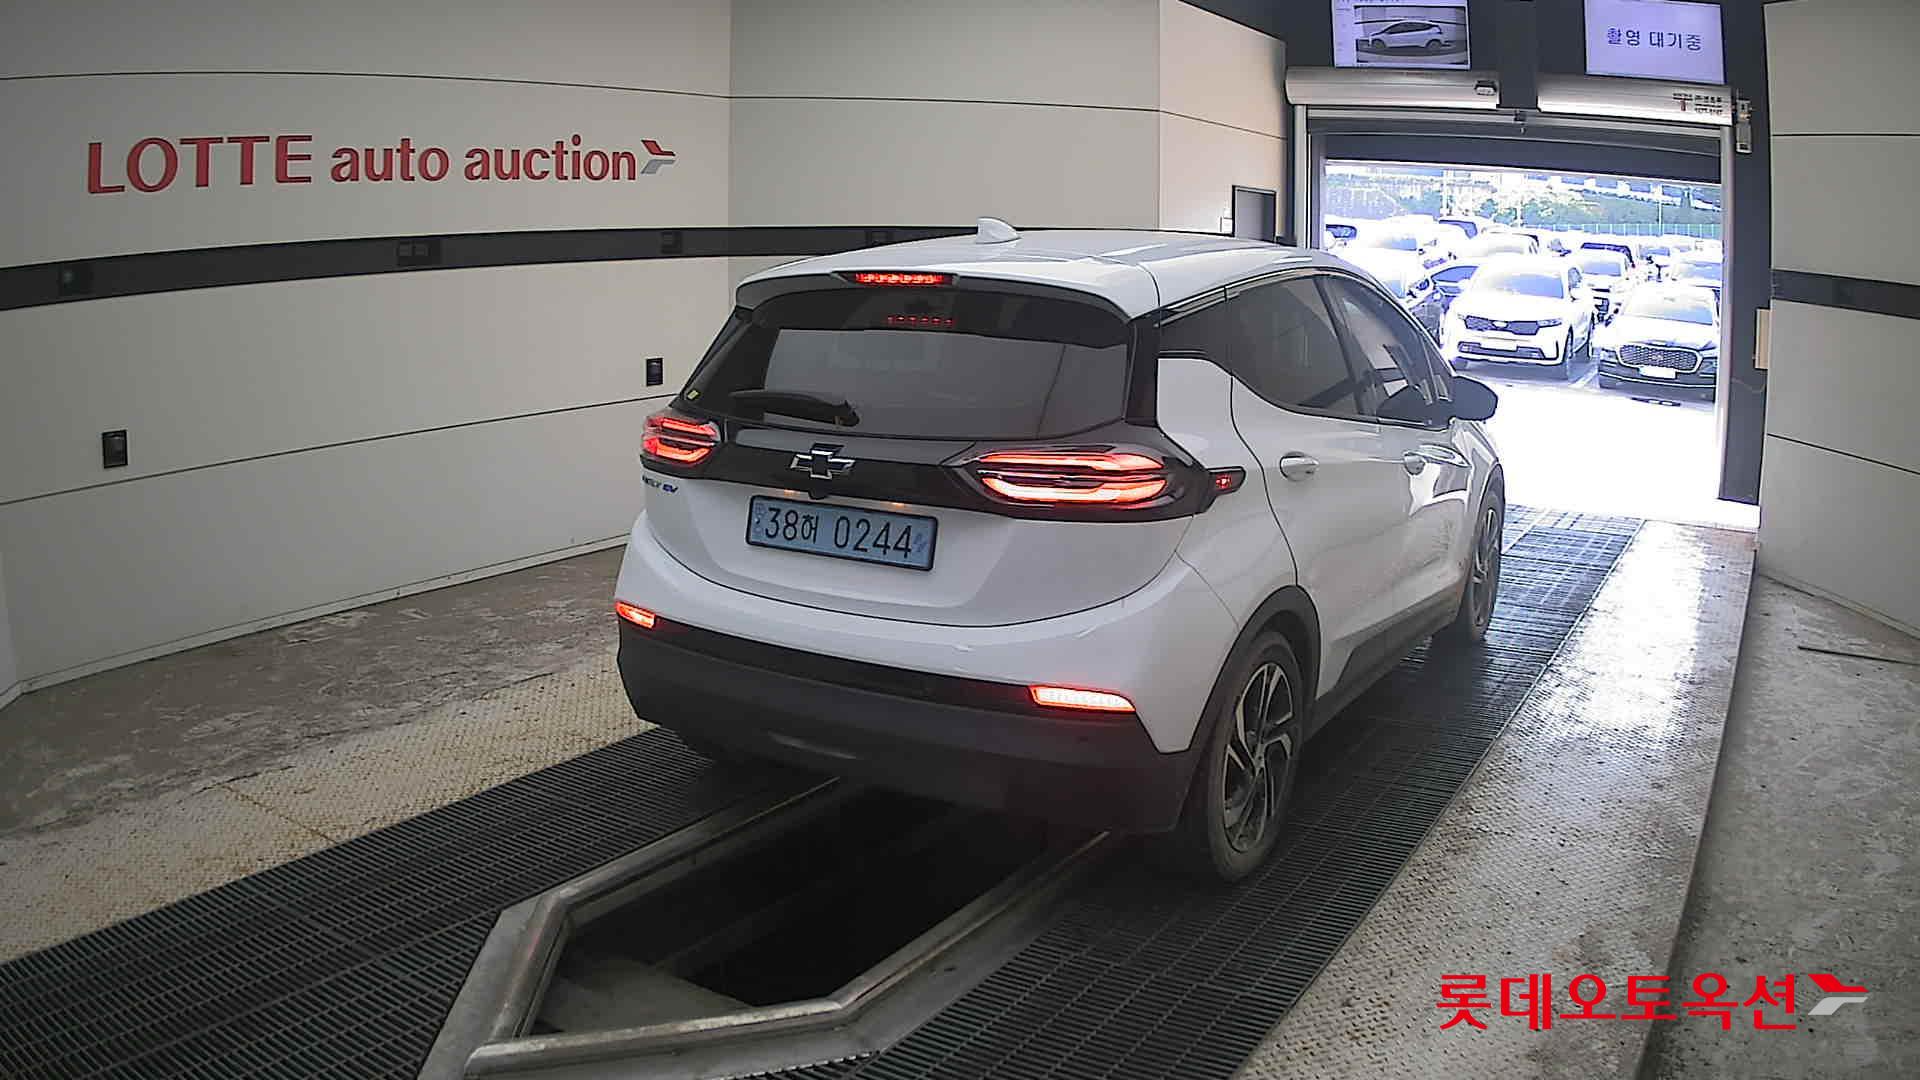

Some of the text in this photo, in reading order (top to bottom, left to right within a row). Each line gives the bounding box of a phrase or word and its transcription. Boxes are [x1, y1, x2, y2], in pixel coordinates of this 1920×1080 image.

[1648, 31, 1702, 52] 대기중
[87, 134, 637, 195] LOTTE auto auction
[833, 515, 913, 559] 0244
